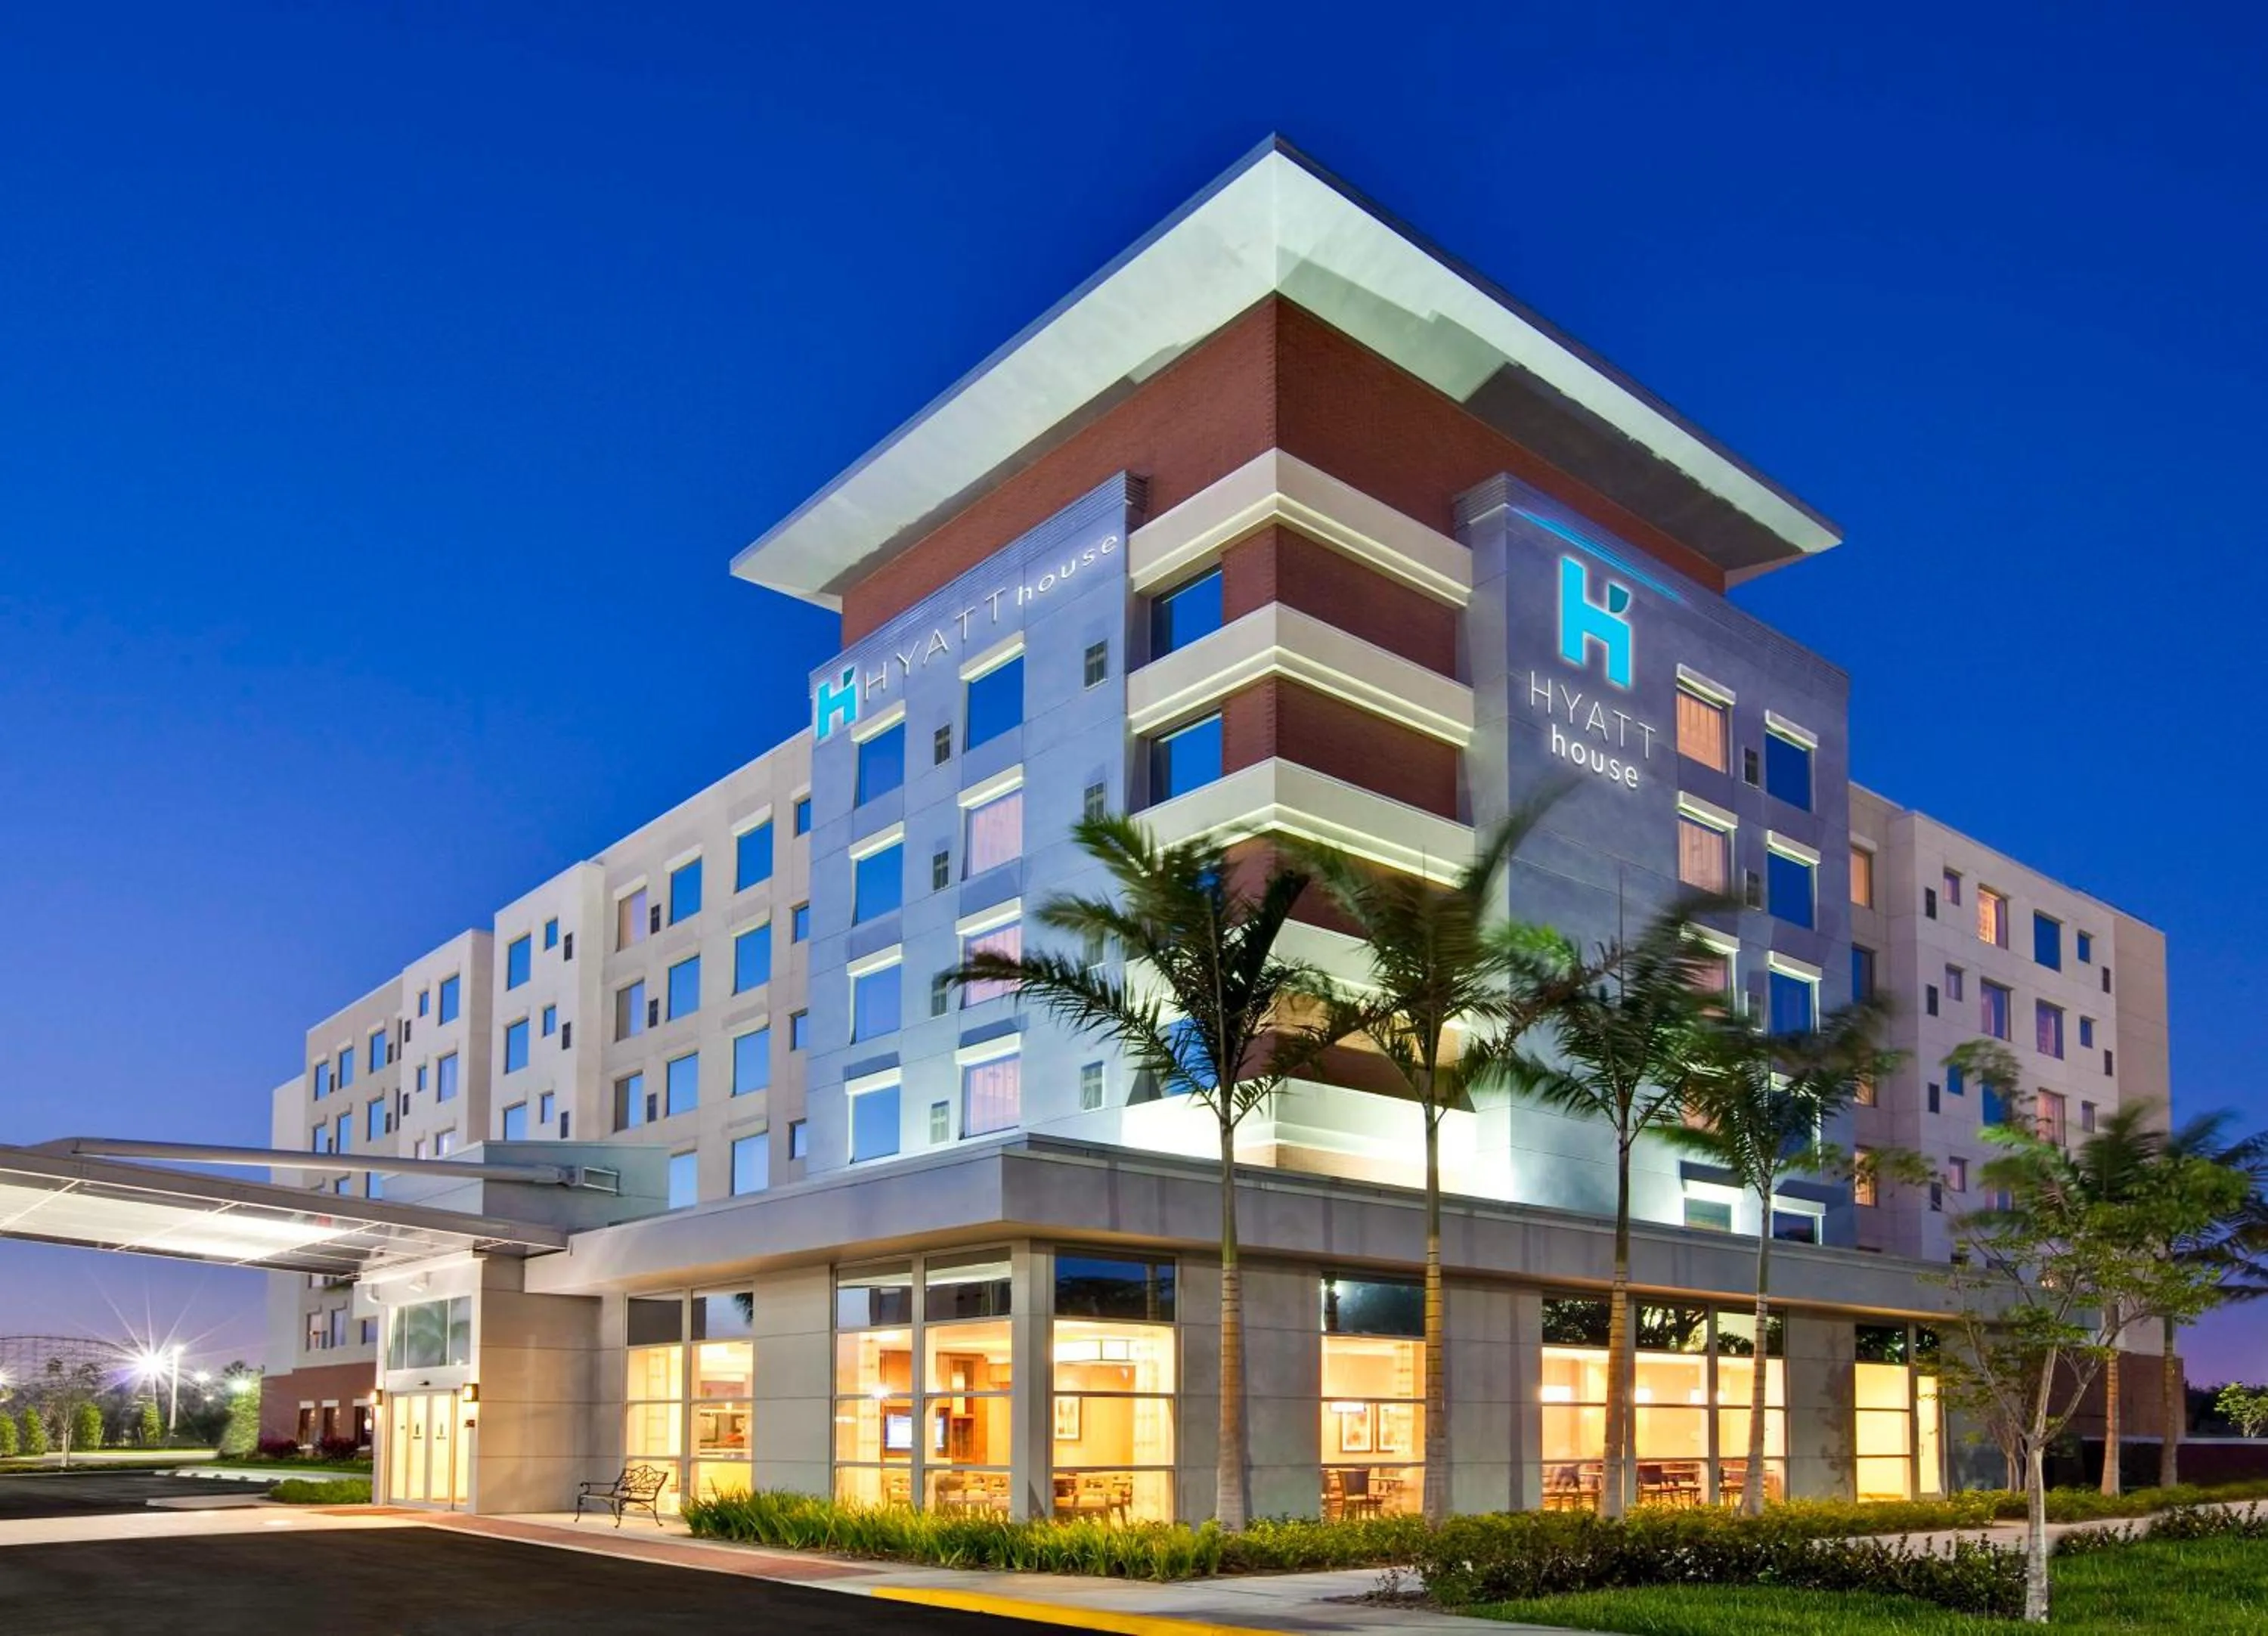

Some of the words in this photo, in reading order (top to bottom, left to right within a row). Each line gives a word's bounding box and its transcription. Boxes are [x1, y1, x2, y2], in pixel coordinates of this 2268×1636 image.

[863, 587, 1006, 702] HYATT
[1015, 534, 1118, 606] house
[1530, 670, 1656, 759] HYATT
[1551, 723, 1639, 789] house
